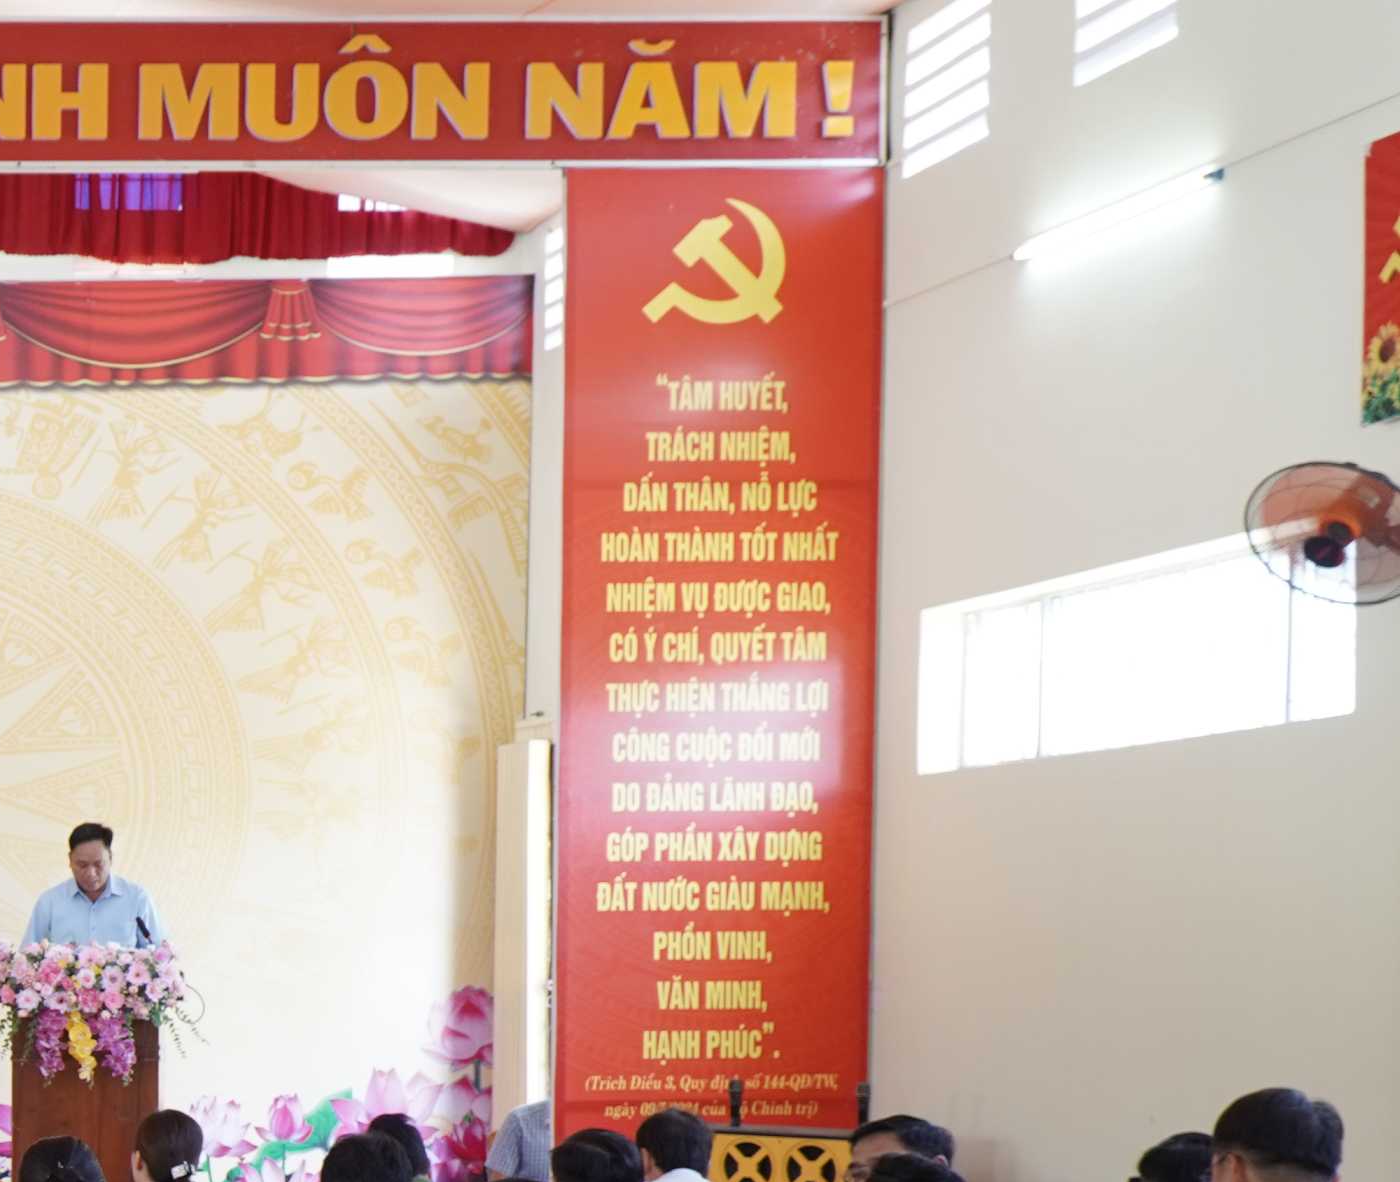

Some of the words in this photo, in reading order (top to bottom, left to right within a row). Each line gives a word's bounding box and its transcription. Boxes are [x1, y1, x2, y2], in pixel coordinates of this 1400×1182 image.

[137, 34, 491, 142] MUÔN
[524, 37, 798, 141] NĂM
[821, 60, 855, 138] !
[655, 373, 714, 412] “TÂM
[645, 425, 715, 462] TRÁCH
[719, 425, 797, 468] NHIỆM,
[716, 930, 773, 963] VINH,
[656, 974, 700, 1010] VĂN
[705, 980, 768, 1013] MINH,
[642, 1030, 701, 1066] HẠNH
[705, 1021, 781, 1060] PHÚC”.
